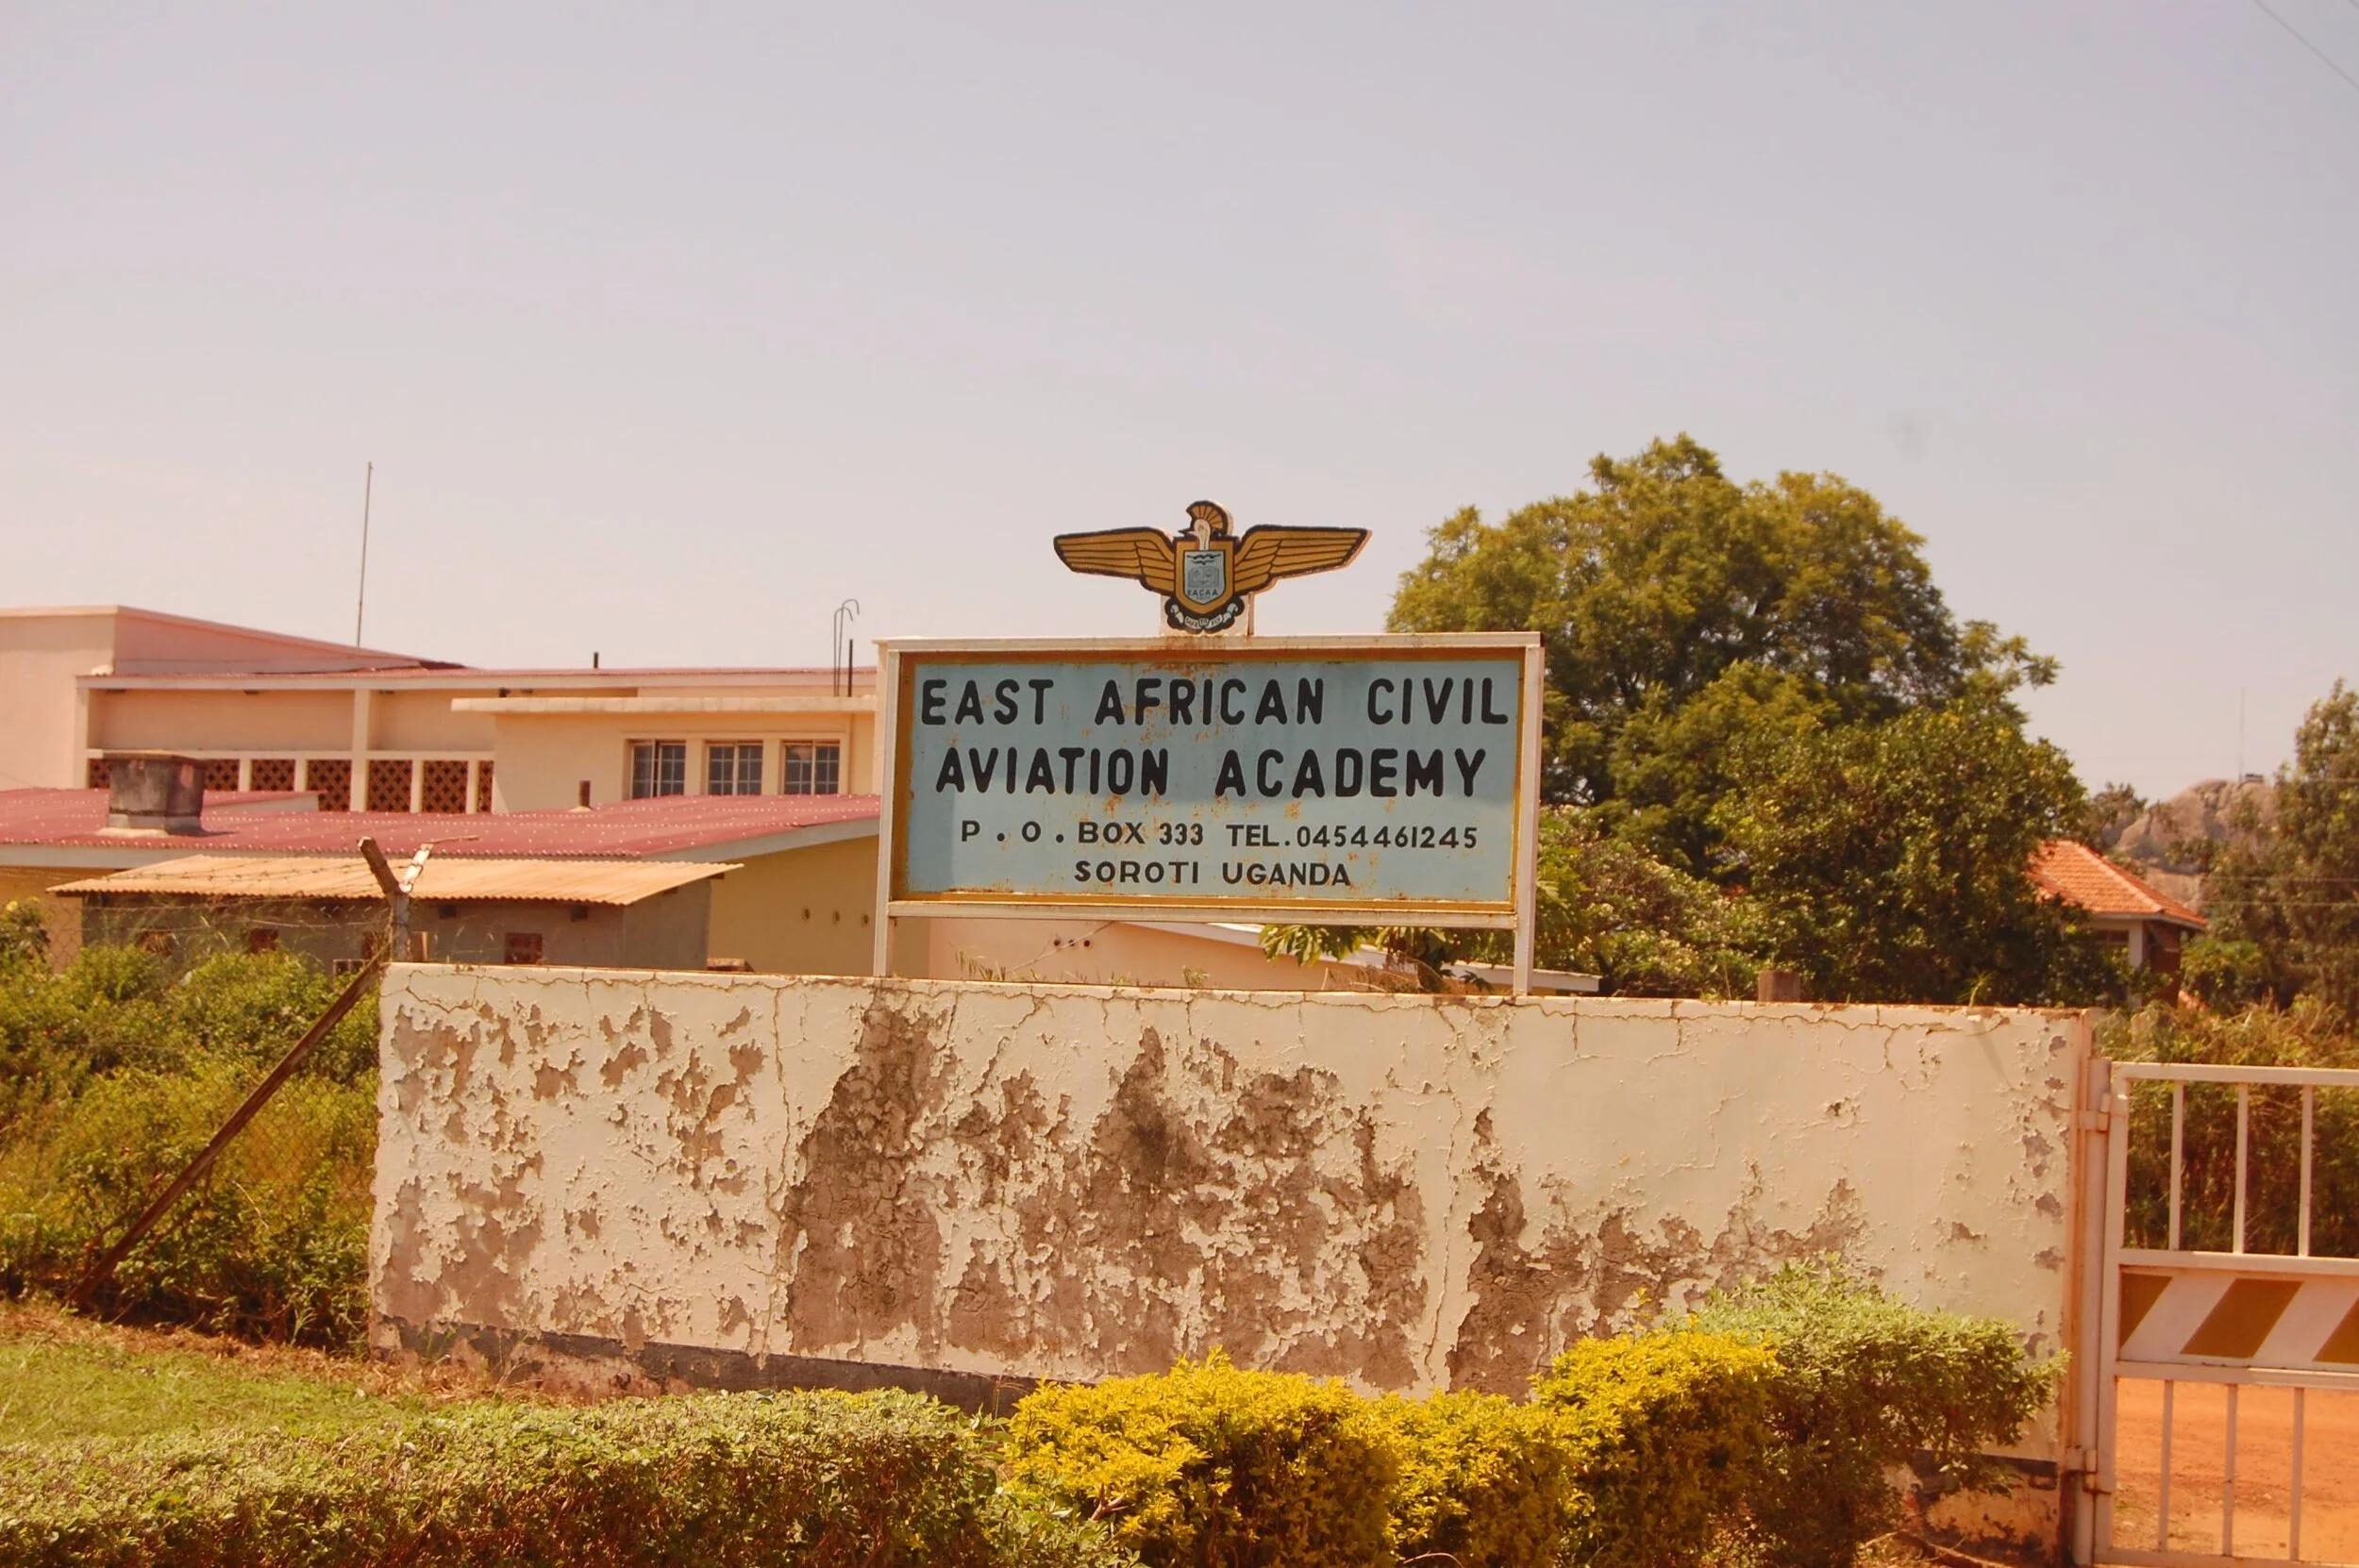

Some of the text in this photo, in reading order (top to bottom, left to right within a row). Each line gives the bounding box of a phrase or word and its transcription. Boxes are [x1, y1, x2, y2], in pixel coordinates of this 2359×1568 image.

[921, 676, 1509, 726] EAST AFRICAN CIVIL
[935, 746, 1486, 799] AVIATION ACADEMY
[1159, 822, 1203, 846] 333
[1074, 860, 1351, 886] SOROTI UGANDA
